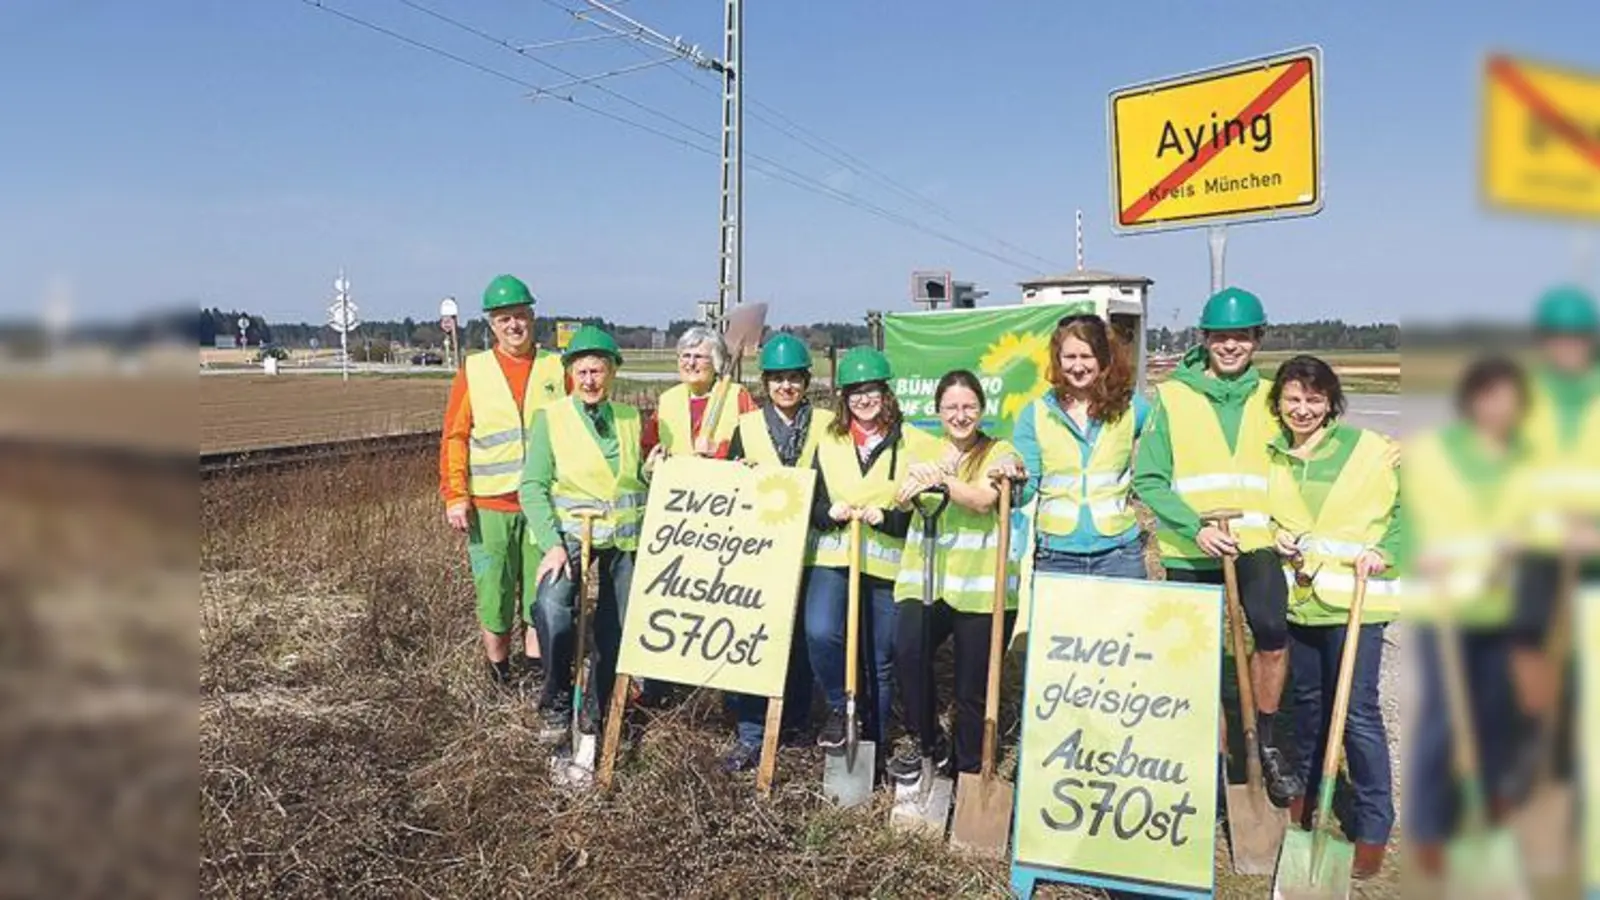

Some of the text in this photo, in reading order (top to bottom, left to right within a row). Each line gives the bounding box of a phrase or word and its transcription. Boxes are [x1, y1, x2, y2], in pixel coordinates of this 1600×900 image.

[1156, 111, 1273, 162] Aying
[1148, 171, 1282, 202] Kreis München
[647, 518, 773, 566] gleisiger
[644, 554, 766, 609] Ausbau
[1036, 672, 1190, 728] gleisiger
[1042, 727, 1188, 784] Ausbau
